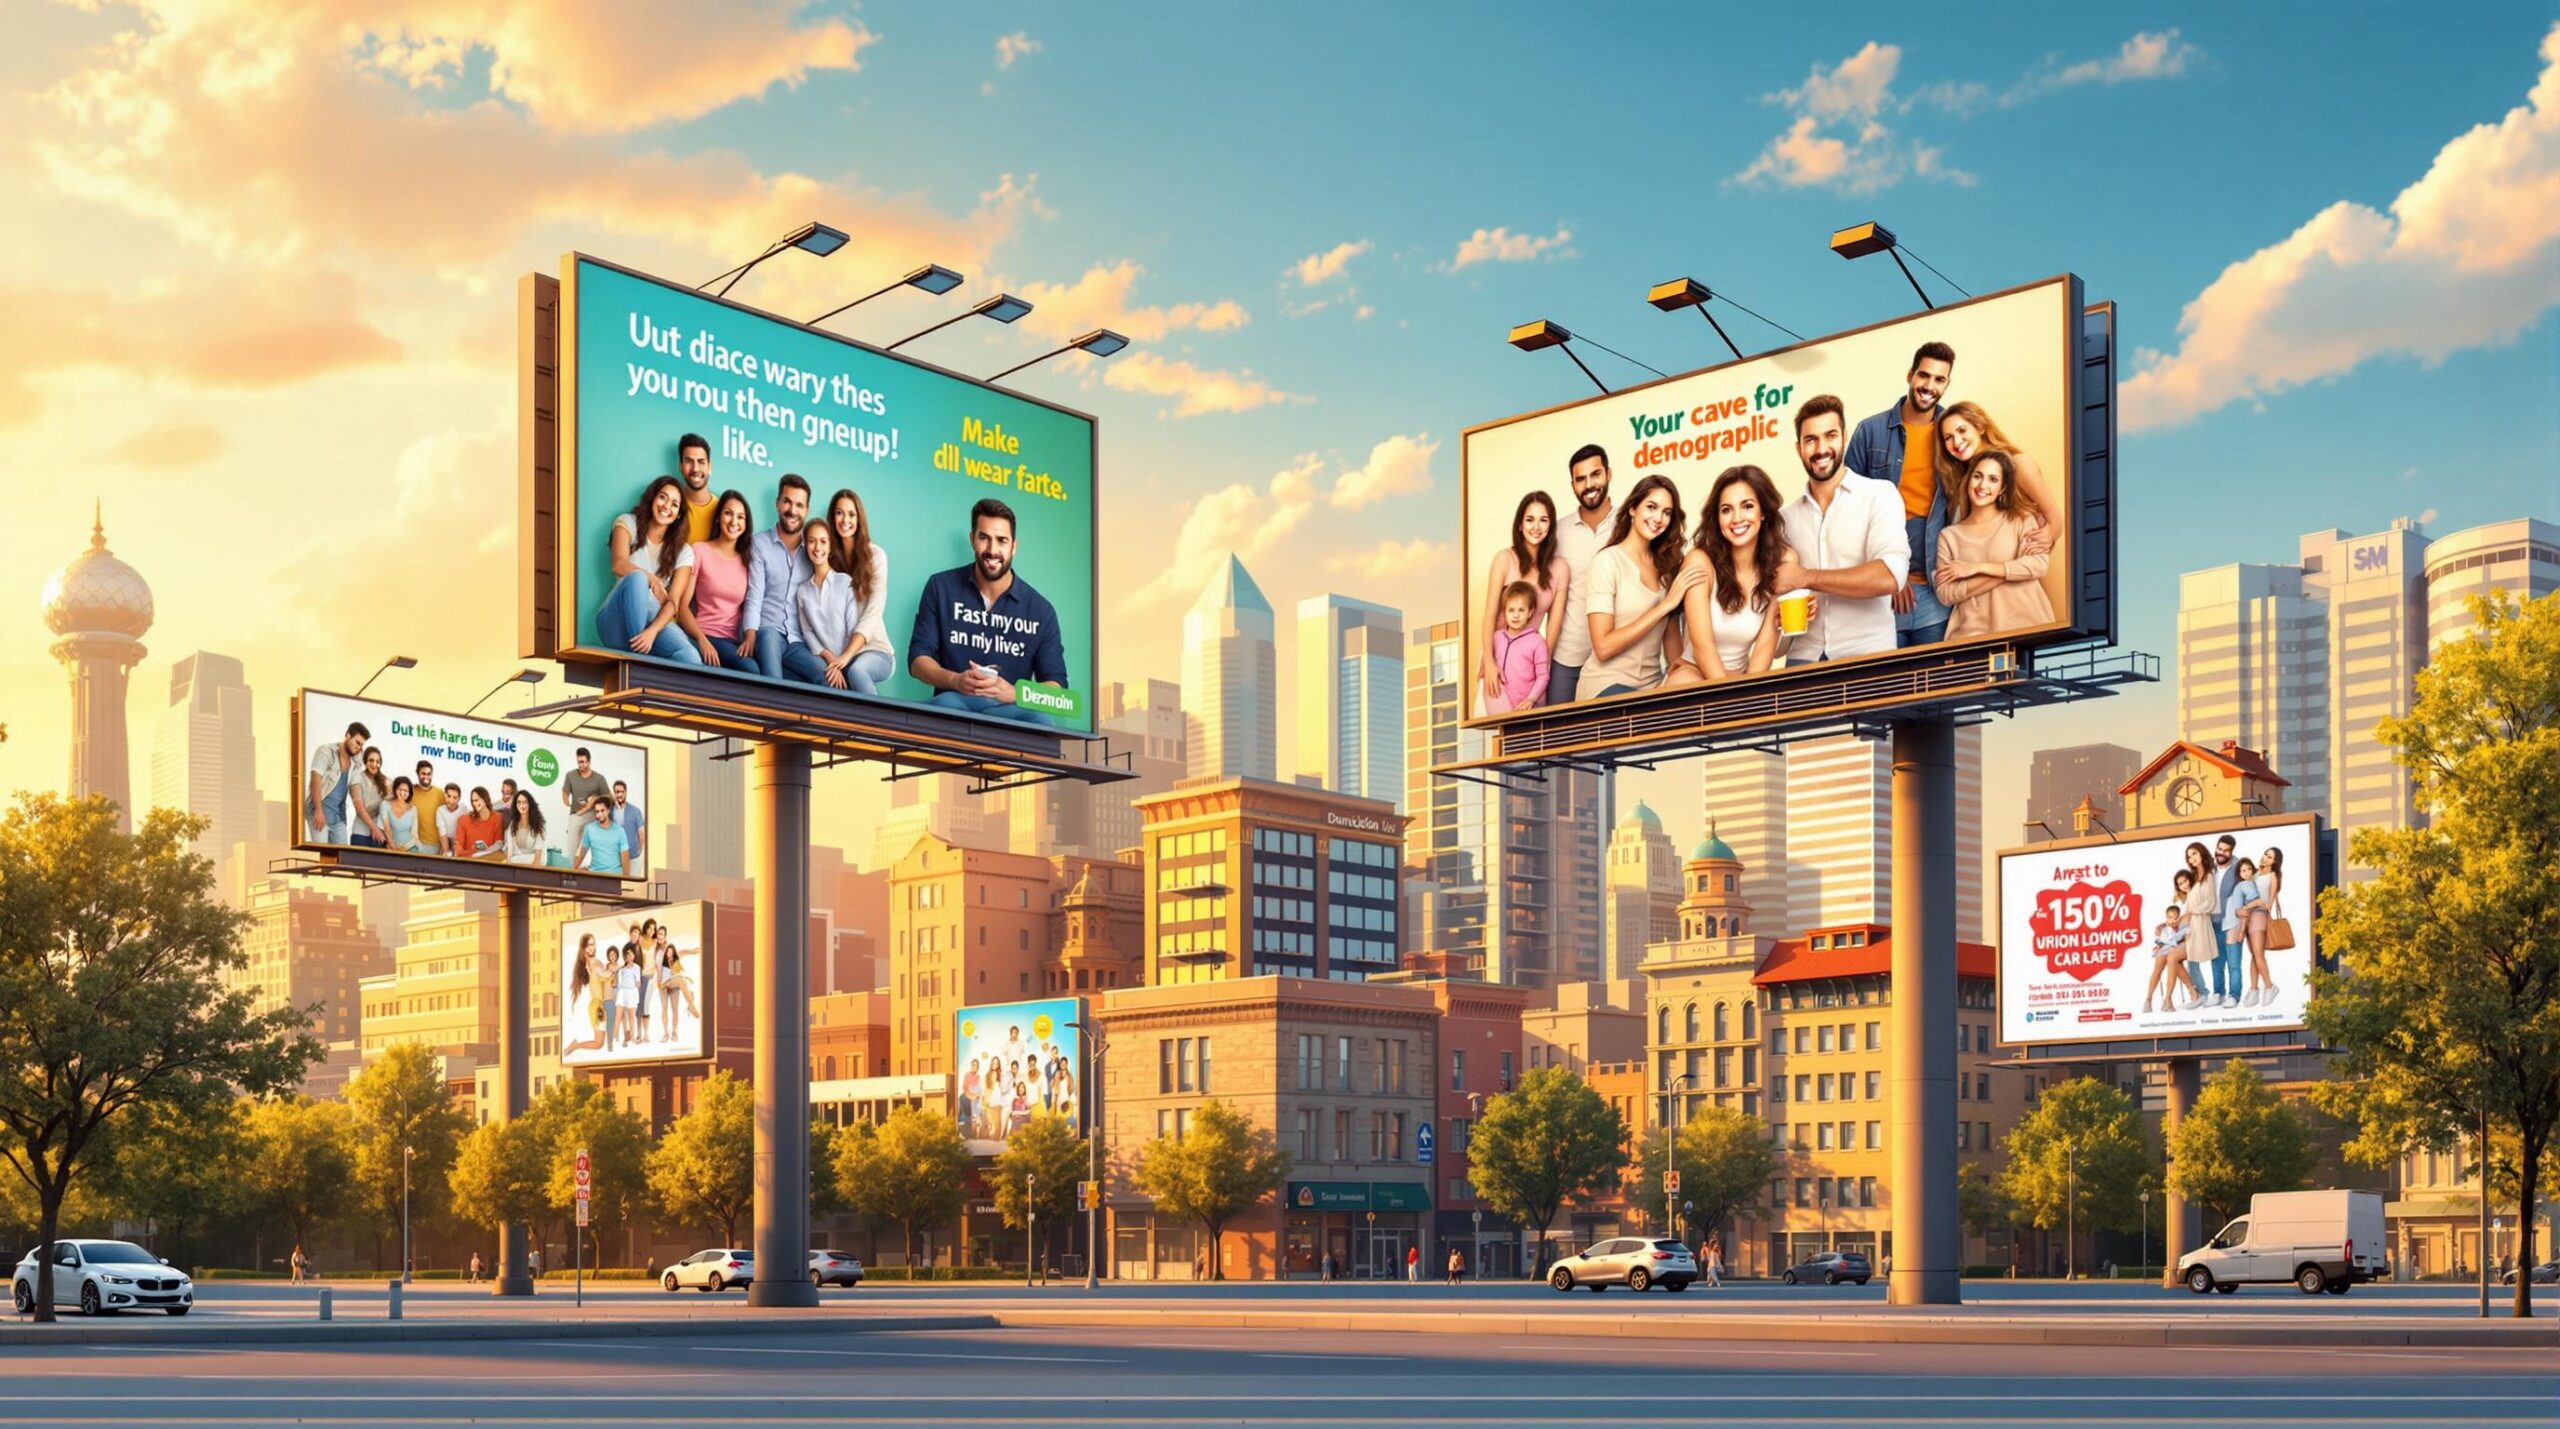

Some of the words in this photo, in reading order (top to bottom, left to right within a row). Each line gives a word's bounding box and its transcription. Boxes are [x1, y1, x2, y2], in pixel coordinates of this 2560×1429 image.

[629, 312, 682, 358] Uut
[689, 329, 758, 379] diace
[763, 358, 827, 404] wary
[830, 373, 887, 416] thes
[626, 362, 678, 397] you
[684, 372, 728, 414] rou
[734, 386, 796, 431] then
[1629, 410, 1685, 440] Your
[1690, 396, 1748, 426] cave
[1753, 383, 1794, 411] for
[722, 424, 774, 468] like.
[961, 416, 1020, 456] Make
[963, 456, 1012, 486] wear
[2353, 545, 2388, 571] SM
[953, 602, 988, 626] Fast
[1014, 618, 1040, 635] our
[950, 630, 968, 646] an
[416, 725, 437, 740] the
[2094, 863, 2109, 877] to
[2048, 893, 2130, 931] 150%
[2054, 951, 2081, 967] CAR
